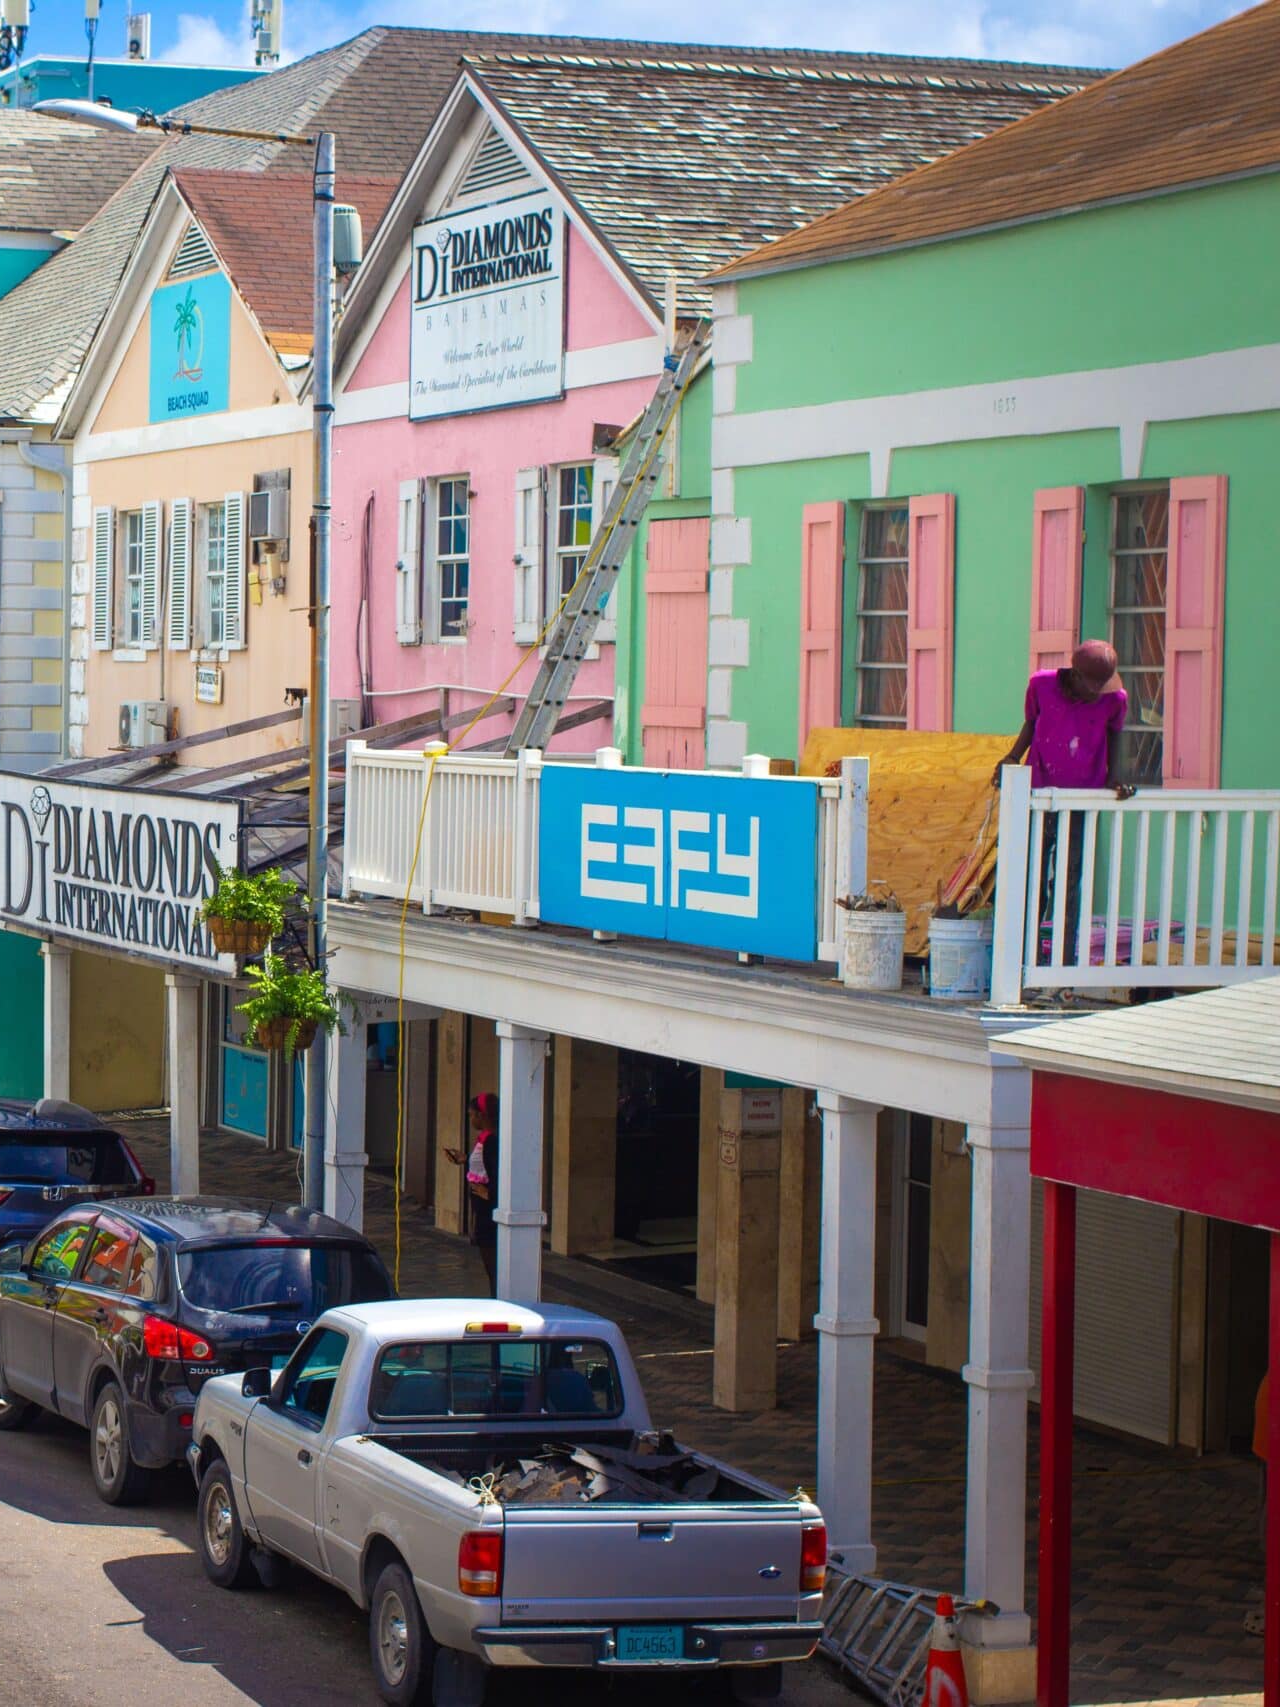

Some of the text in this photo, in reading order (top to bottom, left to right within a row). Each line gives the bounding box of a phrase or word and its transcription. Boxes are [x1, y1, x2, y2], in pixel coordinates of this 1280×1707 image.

[451, 207, 553, 268] DIAMONDS
[451, 248, 553, 294] INTERNATIONAL
[500, 336, 525, 353] World
[519, 359, 557, 377] Caribbean
[167, 390, 209, 412] BEACH SQUAD
[52, 803, 220, 900] DIAMONDS
[580, 803, 760, 919] EFFY
